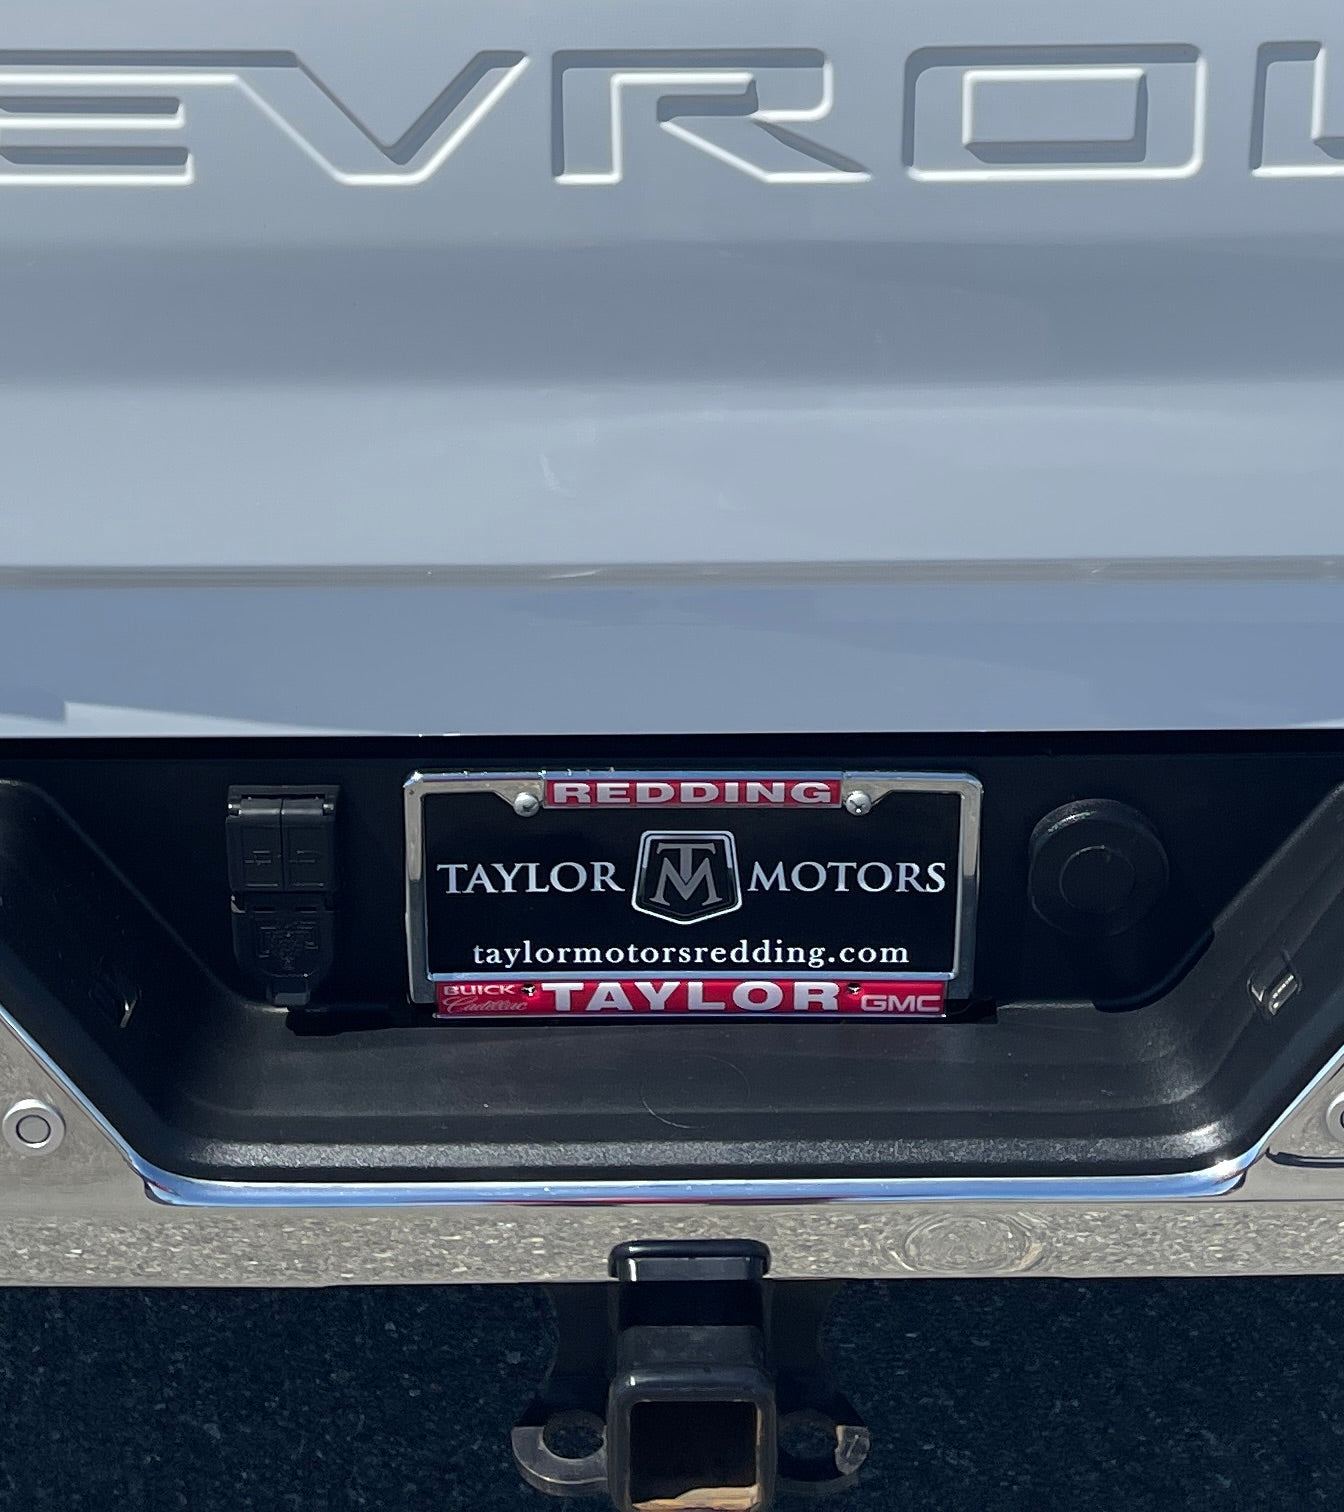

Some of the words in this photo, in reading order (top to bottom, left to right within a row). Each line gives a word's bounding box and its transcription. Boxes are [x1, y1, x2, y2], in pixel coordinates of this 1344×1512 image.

[553, 781, 832, 804] REDDING
[436, 861, 626, 895] TAYLOR
[747, 861, 947, 894] MOTORS
[472, 939, 910, 969] taylormotorsredding.com
[443, 984, 516, 996] BUICK
[541, 980, 840, 1012] TAYLOR
[860, 994, 941, 1013] GMC
